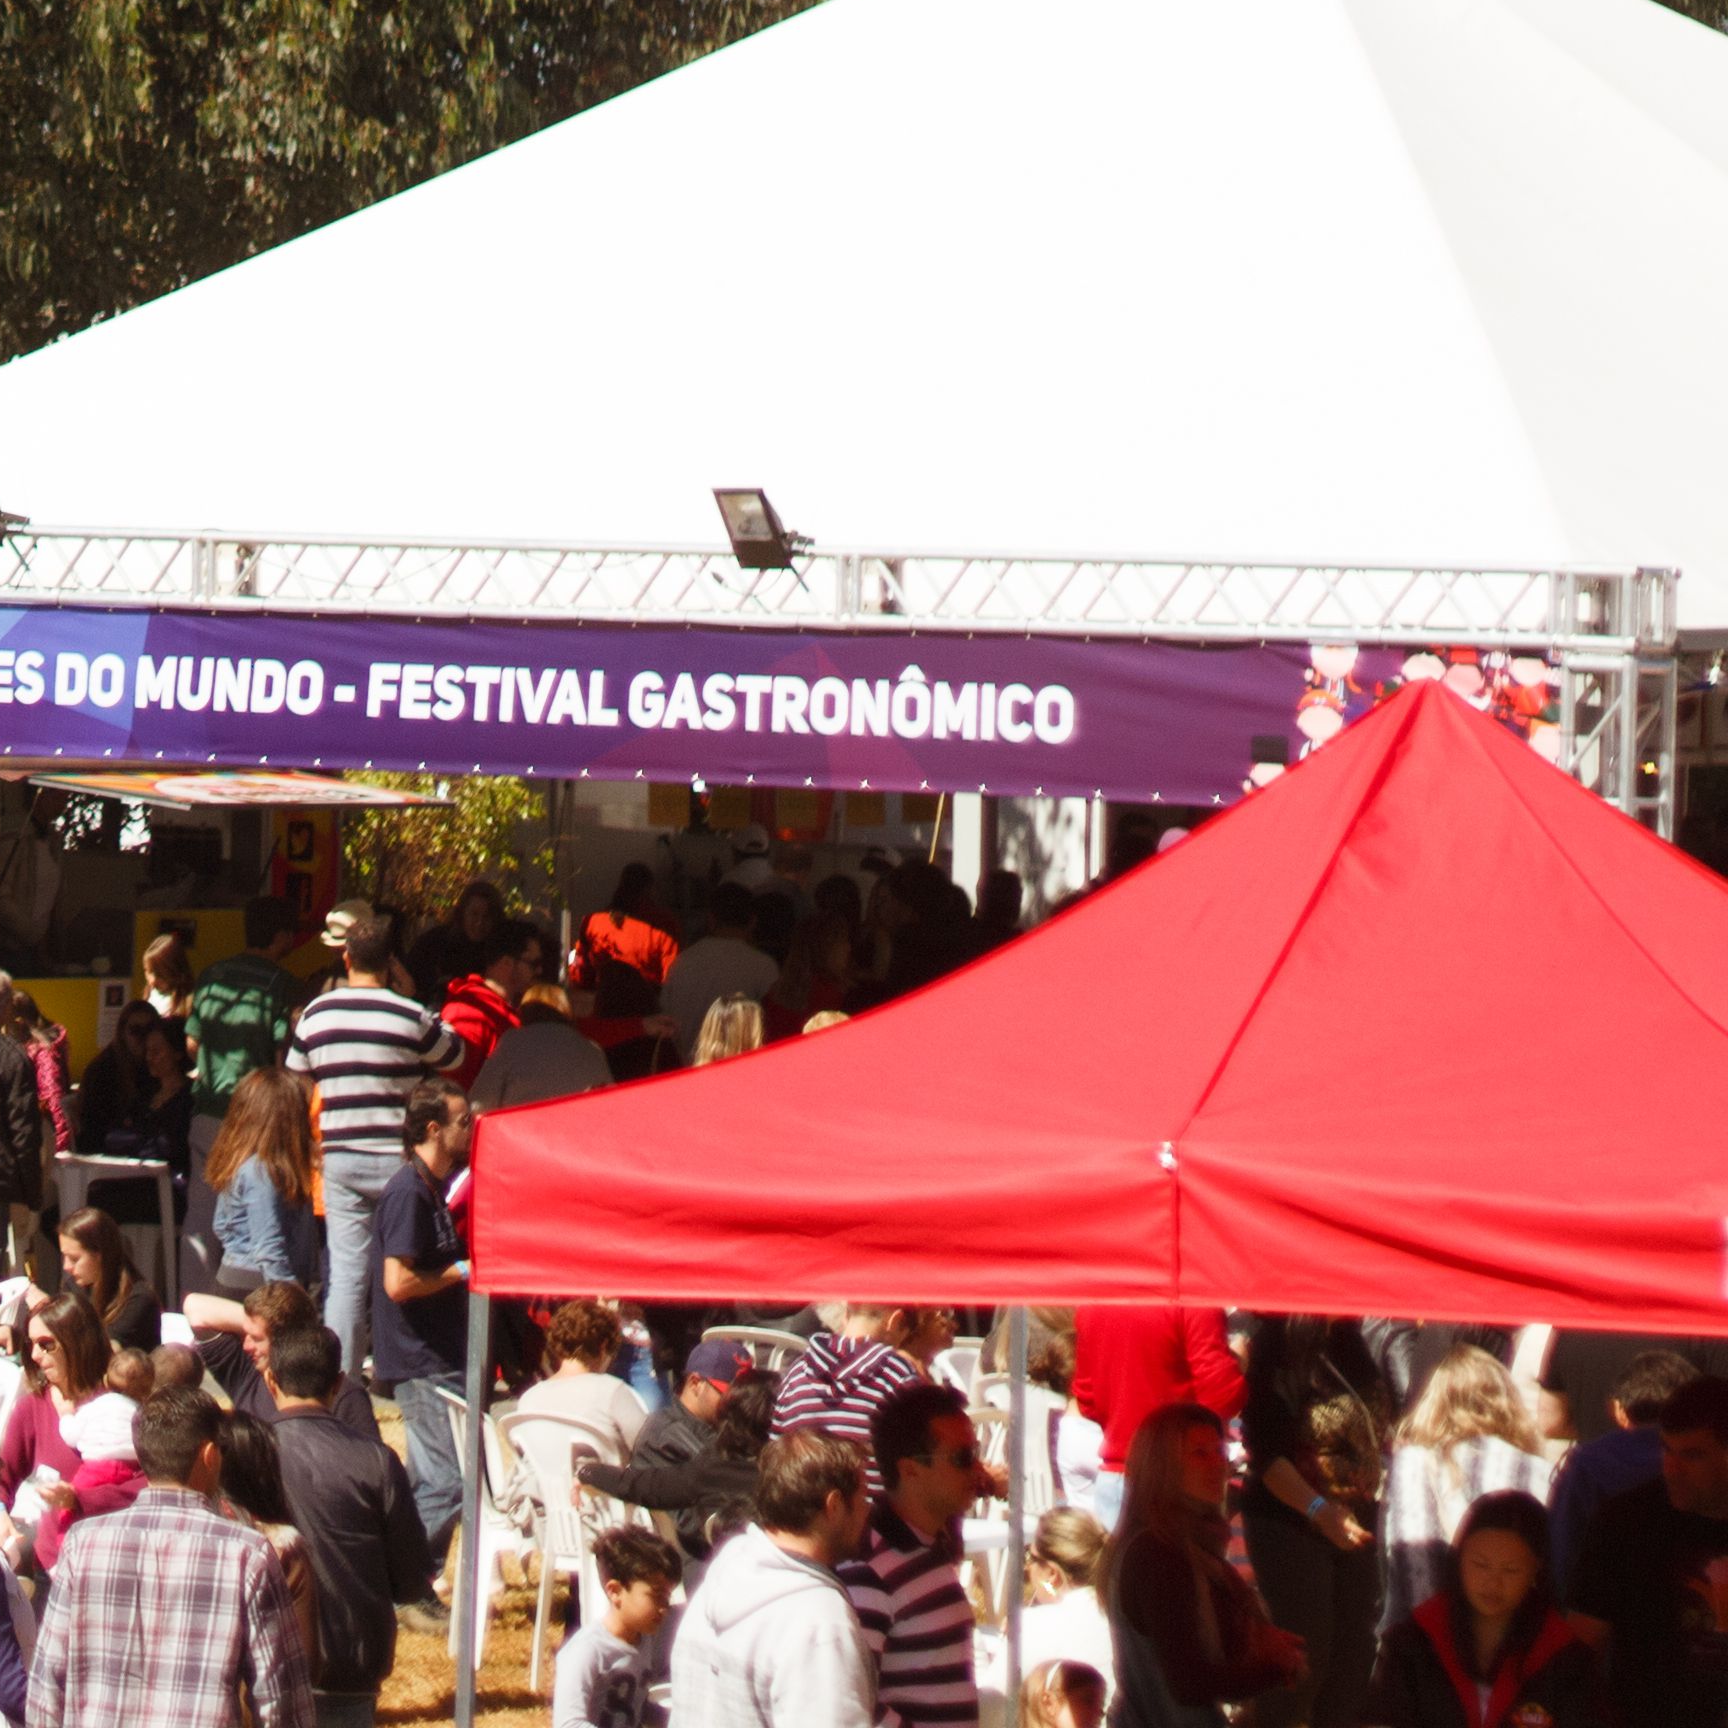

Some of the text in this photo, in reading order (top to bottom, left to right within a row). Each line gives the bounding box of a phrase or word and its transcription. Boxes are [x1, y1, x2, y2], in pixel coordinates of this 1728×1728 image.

[54, 651, 126, 709] DO
[134, 654, 324, 716] MUNDO
[365, 662, 620, 727] FESTIVAL
[627, 664, 1076, 745] GASTRONÔMICO
